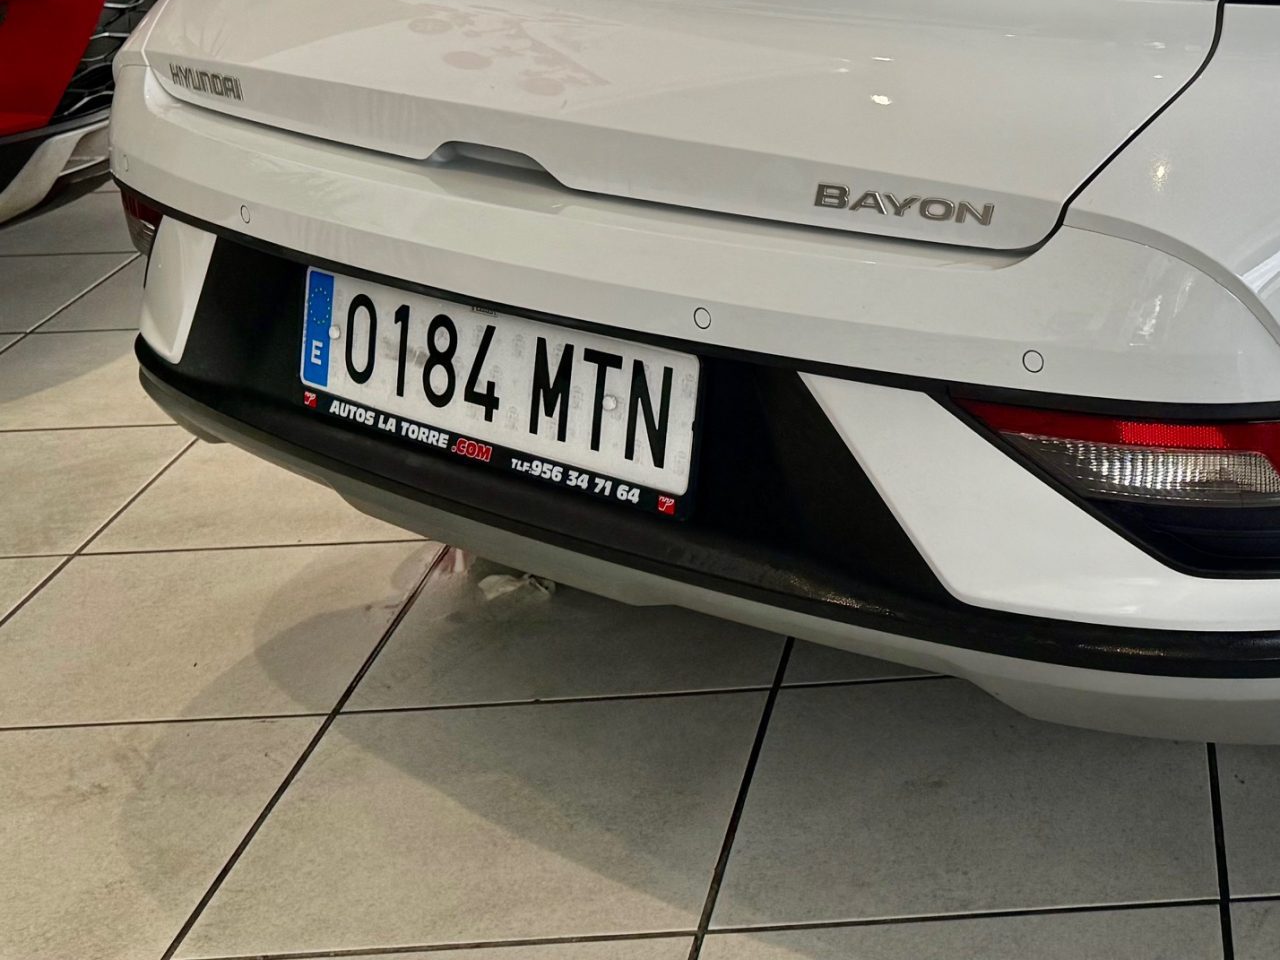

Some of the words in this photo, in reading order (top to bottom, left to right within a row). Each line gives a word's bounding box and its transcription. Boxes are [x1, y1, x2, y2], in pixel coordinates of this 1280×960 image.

[168, 63, 244, 100] HYUNDAI
[814, 182, 995, 227] BAYON
[311, 339, 323, 366] E
[345, 293, 499, 423] 0184
[529, 336, 673, 469] MTN
[329, 400, 376, 426] AUTOS
[377, 416, 396, 433] LA
[400, 421, 449, 449] TORRE
[566, 470, 589, 490] 34
[593, 476, 613, 496] 71
[616, 484, 641, 504] 64
